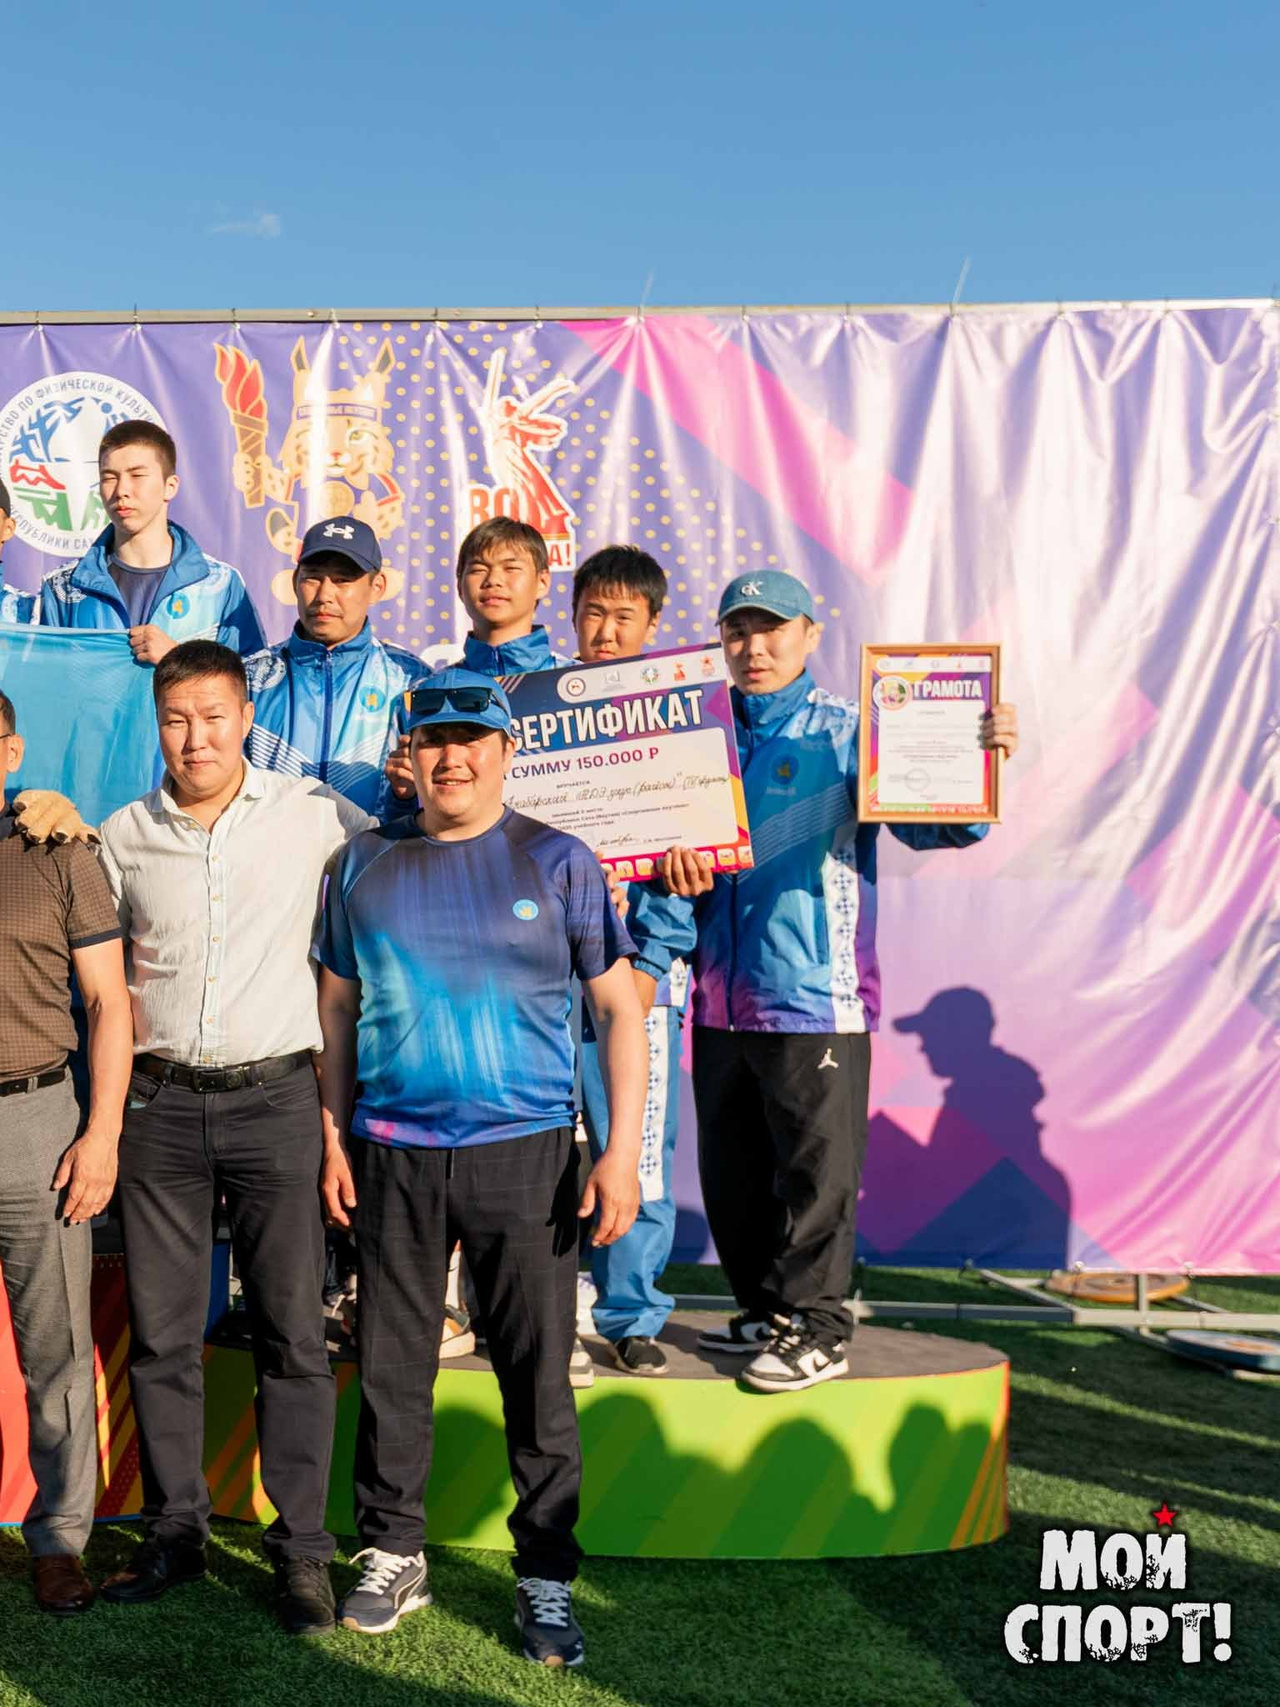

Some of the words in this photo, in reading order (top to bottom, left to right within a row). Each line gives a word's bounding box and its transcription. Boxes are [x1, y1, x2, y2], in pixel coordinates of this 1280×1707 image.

[20, 396, 34, 411] ПО
[36, 378, 113, 399] ФИЗИЧЕСКОЙ
[913, 680, 983, 698] ГРАМОТА
[511, 759, 572, 780] СУММУ
[576, 749, 644, 771] 150.000
